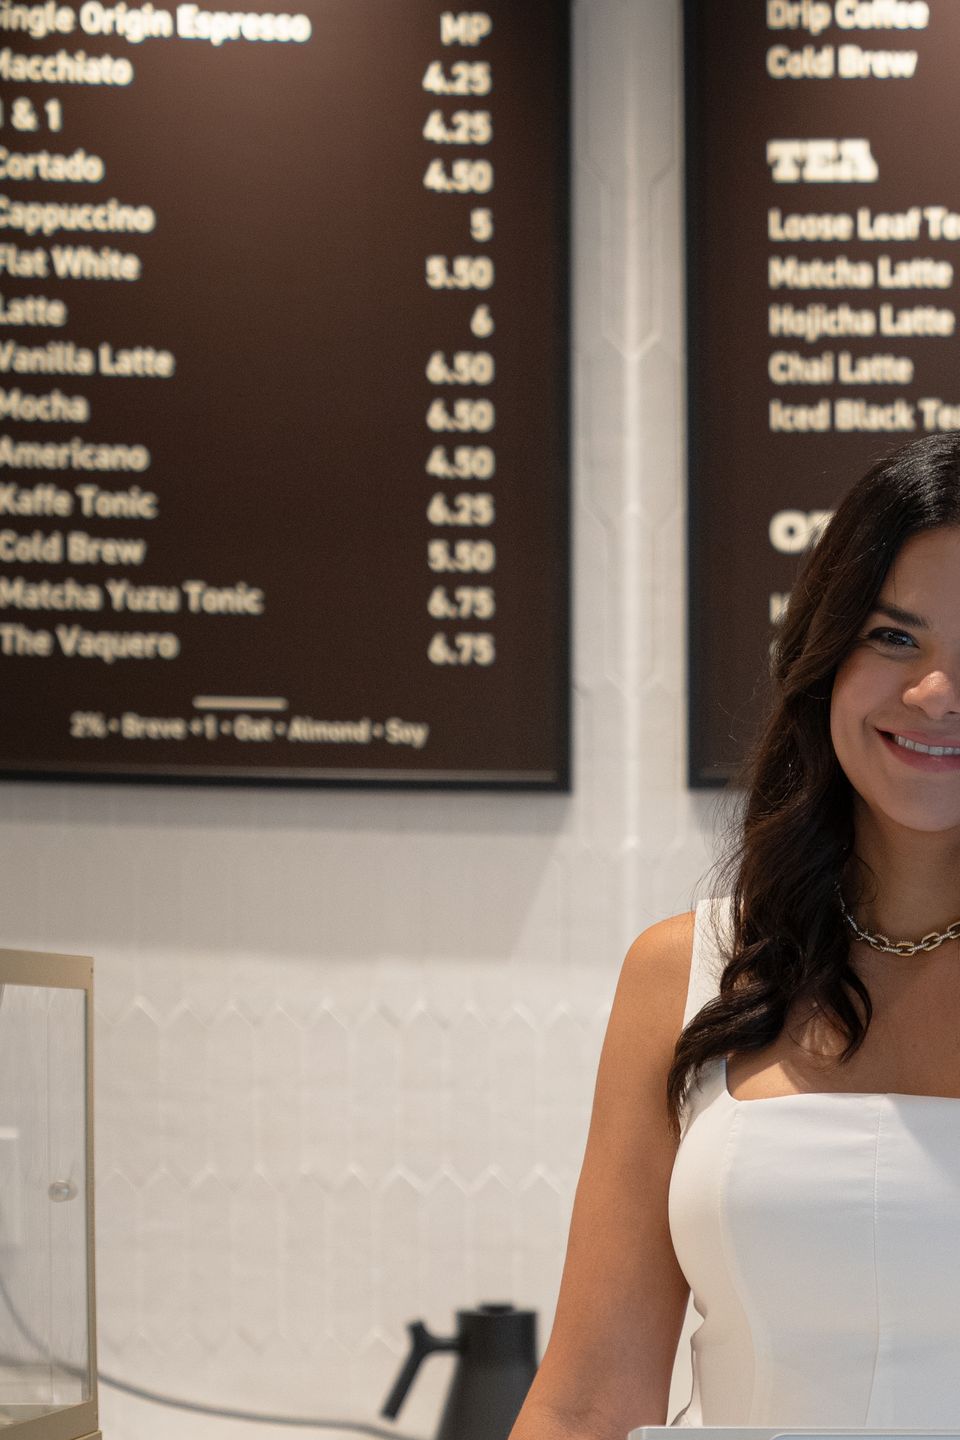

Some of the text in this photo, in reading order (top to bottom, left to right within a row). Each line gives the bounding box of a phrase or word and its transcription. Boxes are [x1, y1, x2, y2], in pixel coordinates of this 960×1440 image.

[0, 0, 312, 46] ingle Origin Espresso
[440, 12, 492, 46] MP
[767, 0, 930, 35] Drip Coffee
[422, 61, 492, 96] 4.25
[766, 45, 919, 79] Cold Brew
[422, 110, 492, 145] 4.25
[423, 159, 493, 193] 4.50
[766, 138, 879, 183] TEA
[470, 208, 493, 242] 5
[767, 208, 854, 241] Loose
[857, 207, 921, 241] Leaf
[51, 246, 141, 281] White
[425, 255, 494, 290] 5.50
[768, 256, 954, 289] Matcha Latte
[470, 305, 494, 337] 6
[768, 304, 956, 342] Hojicha Latte
[98, 343, 175, 378] Latte
[425, 351, 495, 385] 6.50
[768, 351, 914, 384] Chai Latte
[0, 388, 89, 423] Mocha
[426, 399, 495, 432] 6.50
[769, 400, 831, 432] Iced
[834, 399, 915, 431] Black
[0, 436, 150, 472] Americano
[425, 446, 495, 479] 4.50
[75, 484, 157, 519] Tonic
[426, 493, 495, 526] 6.25
[0, 529, 146, 565] Cold Brew
[427, 539, 496, 573] 5.50
[0, 577, 263, 615] Matcha Yuzu Tonic
[427, 586, 495, 619] 6.75
[0, 623, 180, 663] The Vaquero
[427, 633, 495, 666] 6.75
[121, 712, 187, 740] Breve
[287, 717, 371, 744] Almond
[385, 718, 429, 748] Soy
